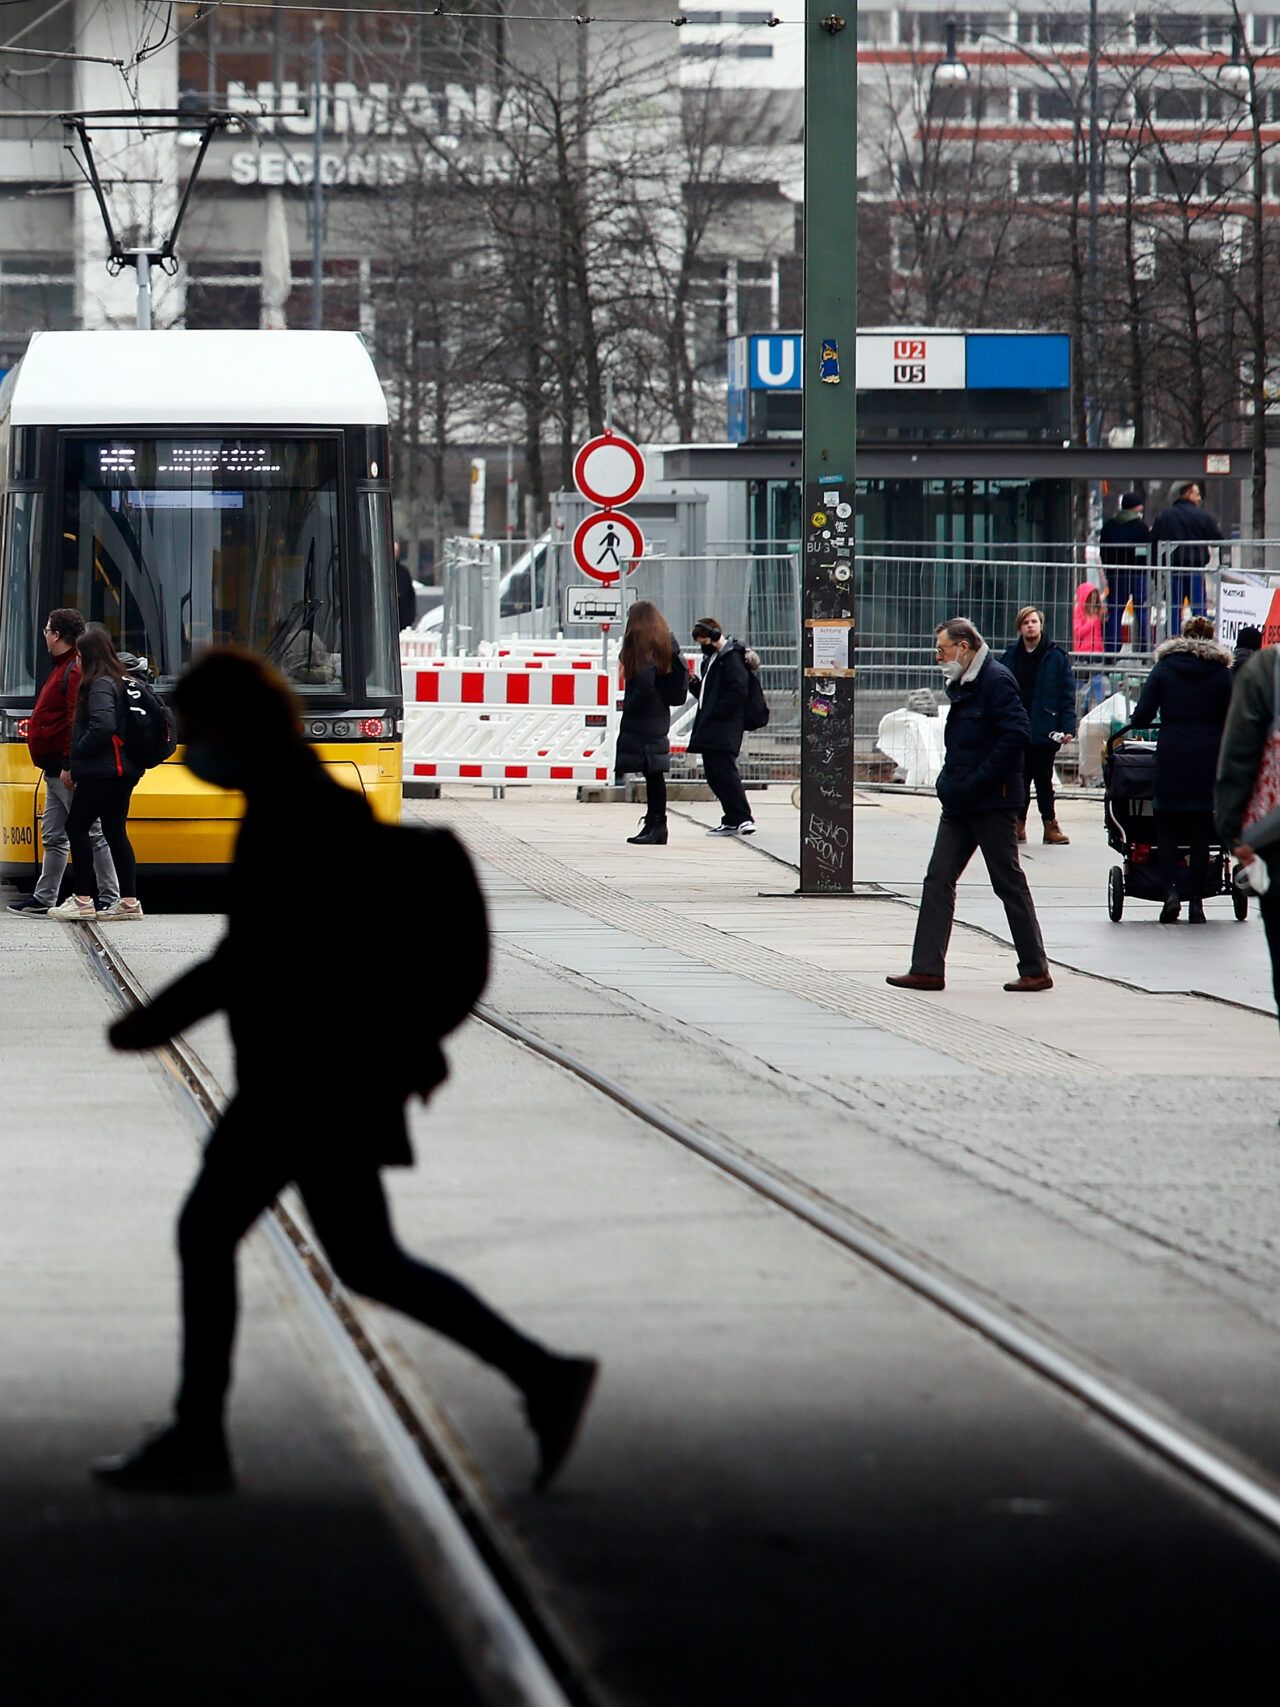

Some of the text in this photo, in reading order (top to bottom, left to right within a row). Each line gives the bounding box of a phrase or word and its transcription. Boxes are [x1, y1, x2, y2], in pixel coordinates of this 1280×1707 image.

[897, 341, 923, 358] U2
[757, 339, 795, 386] U
[897, 365, 923, 382] U5
[2, 826, 33, 845] B-8040
